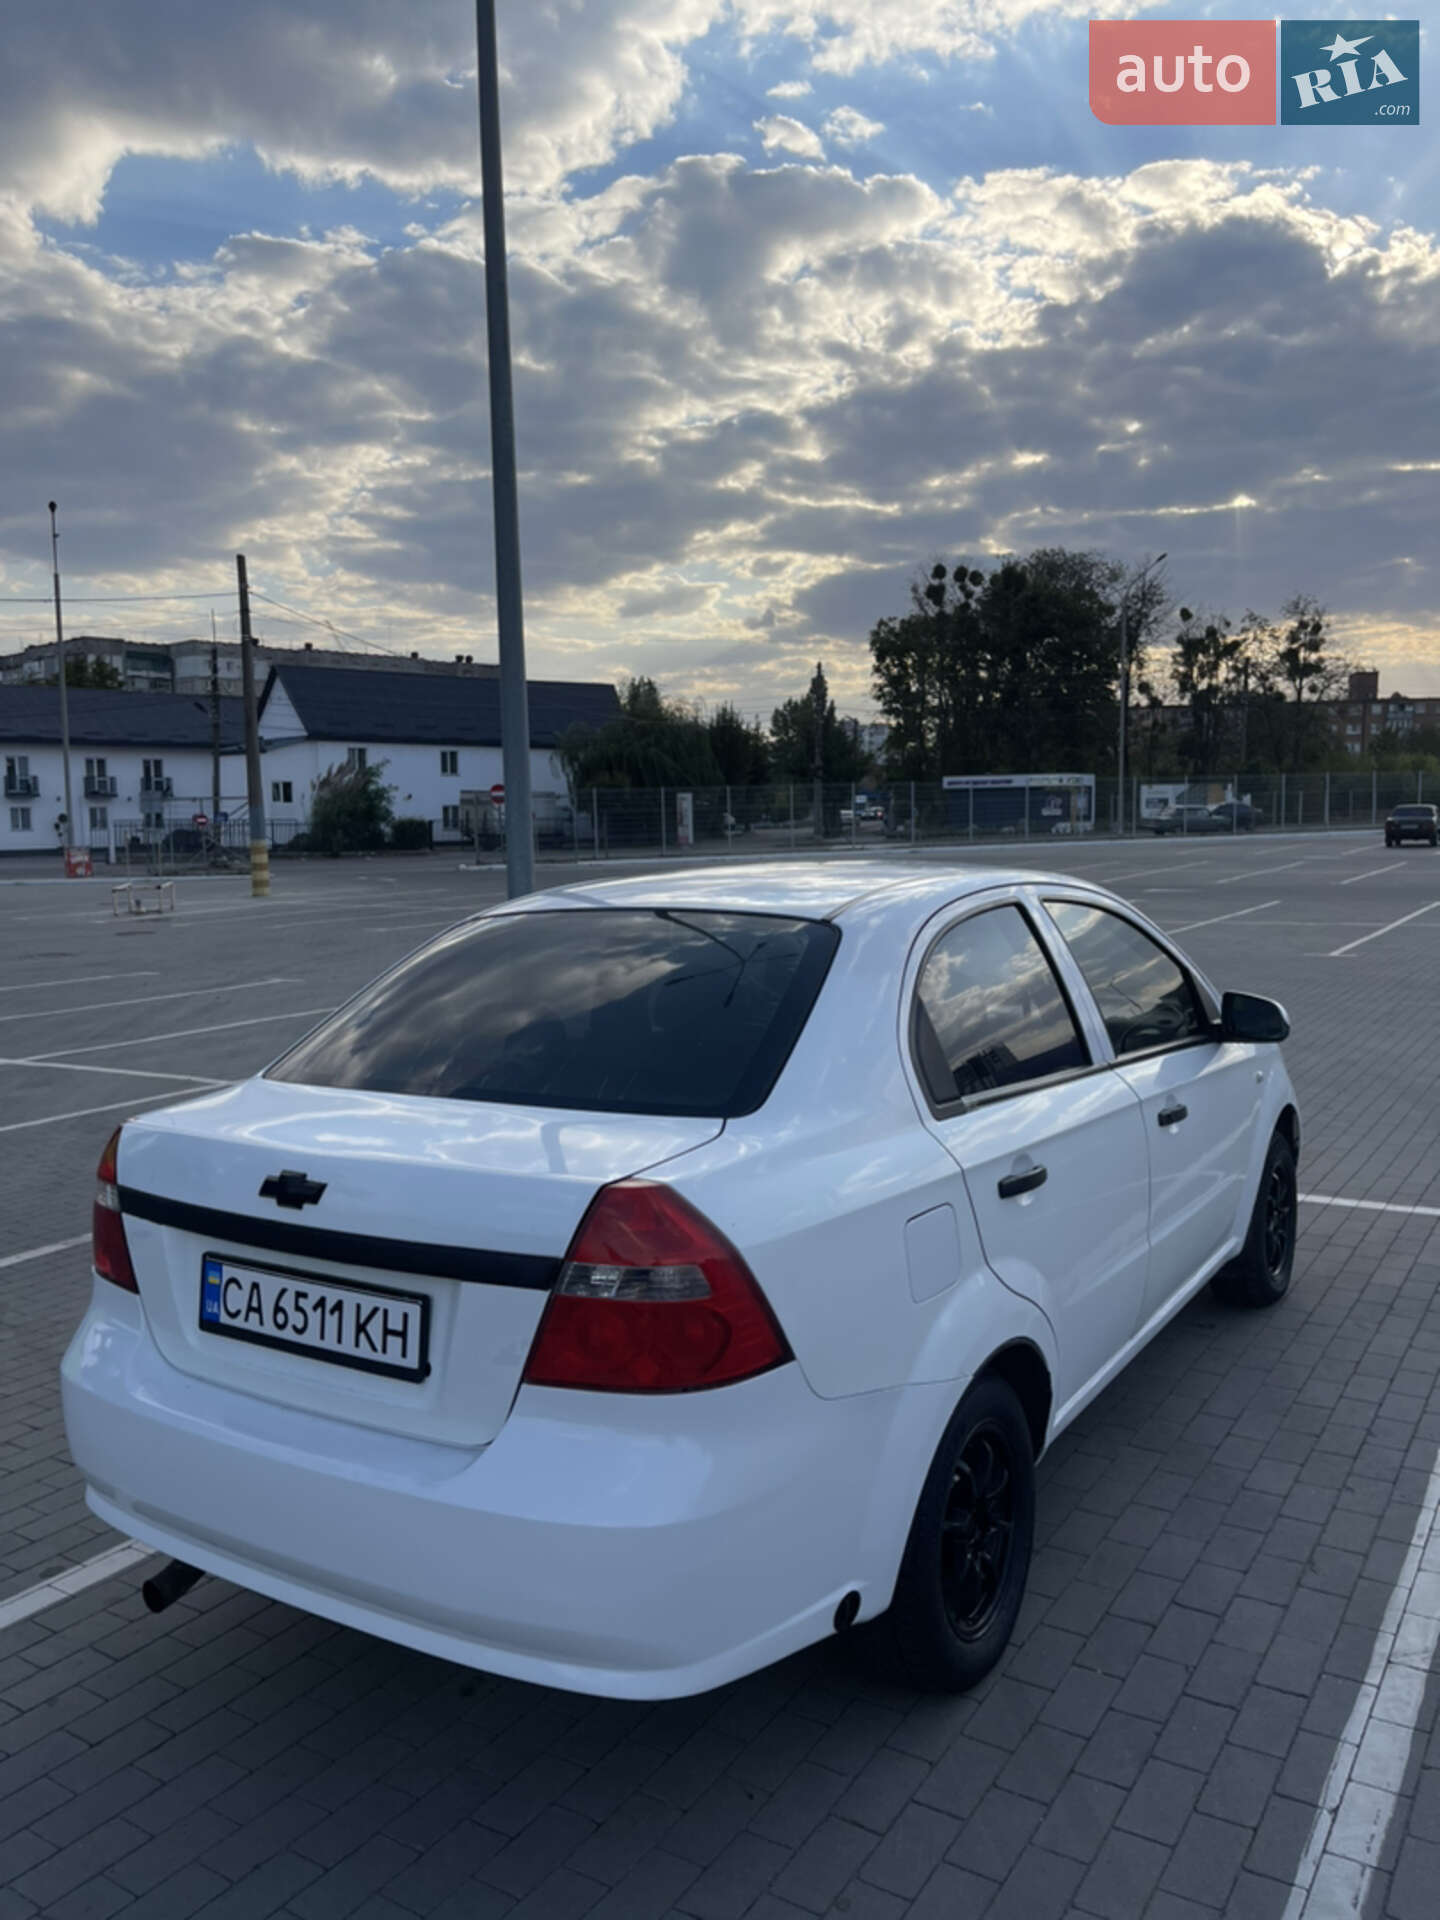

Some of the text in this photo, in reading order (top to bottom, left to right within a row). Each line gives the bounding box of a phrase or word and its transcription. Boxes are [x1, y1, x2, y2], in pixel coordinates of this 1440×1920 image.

[205, 1300, 219, 1314] UA
[223, 1277, 408, 1359] CA 6511 KH
